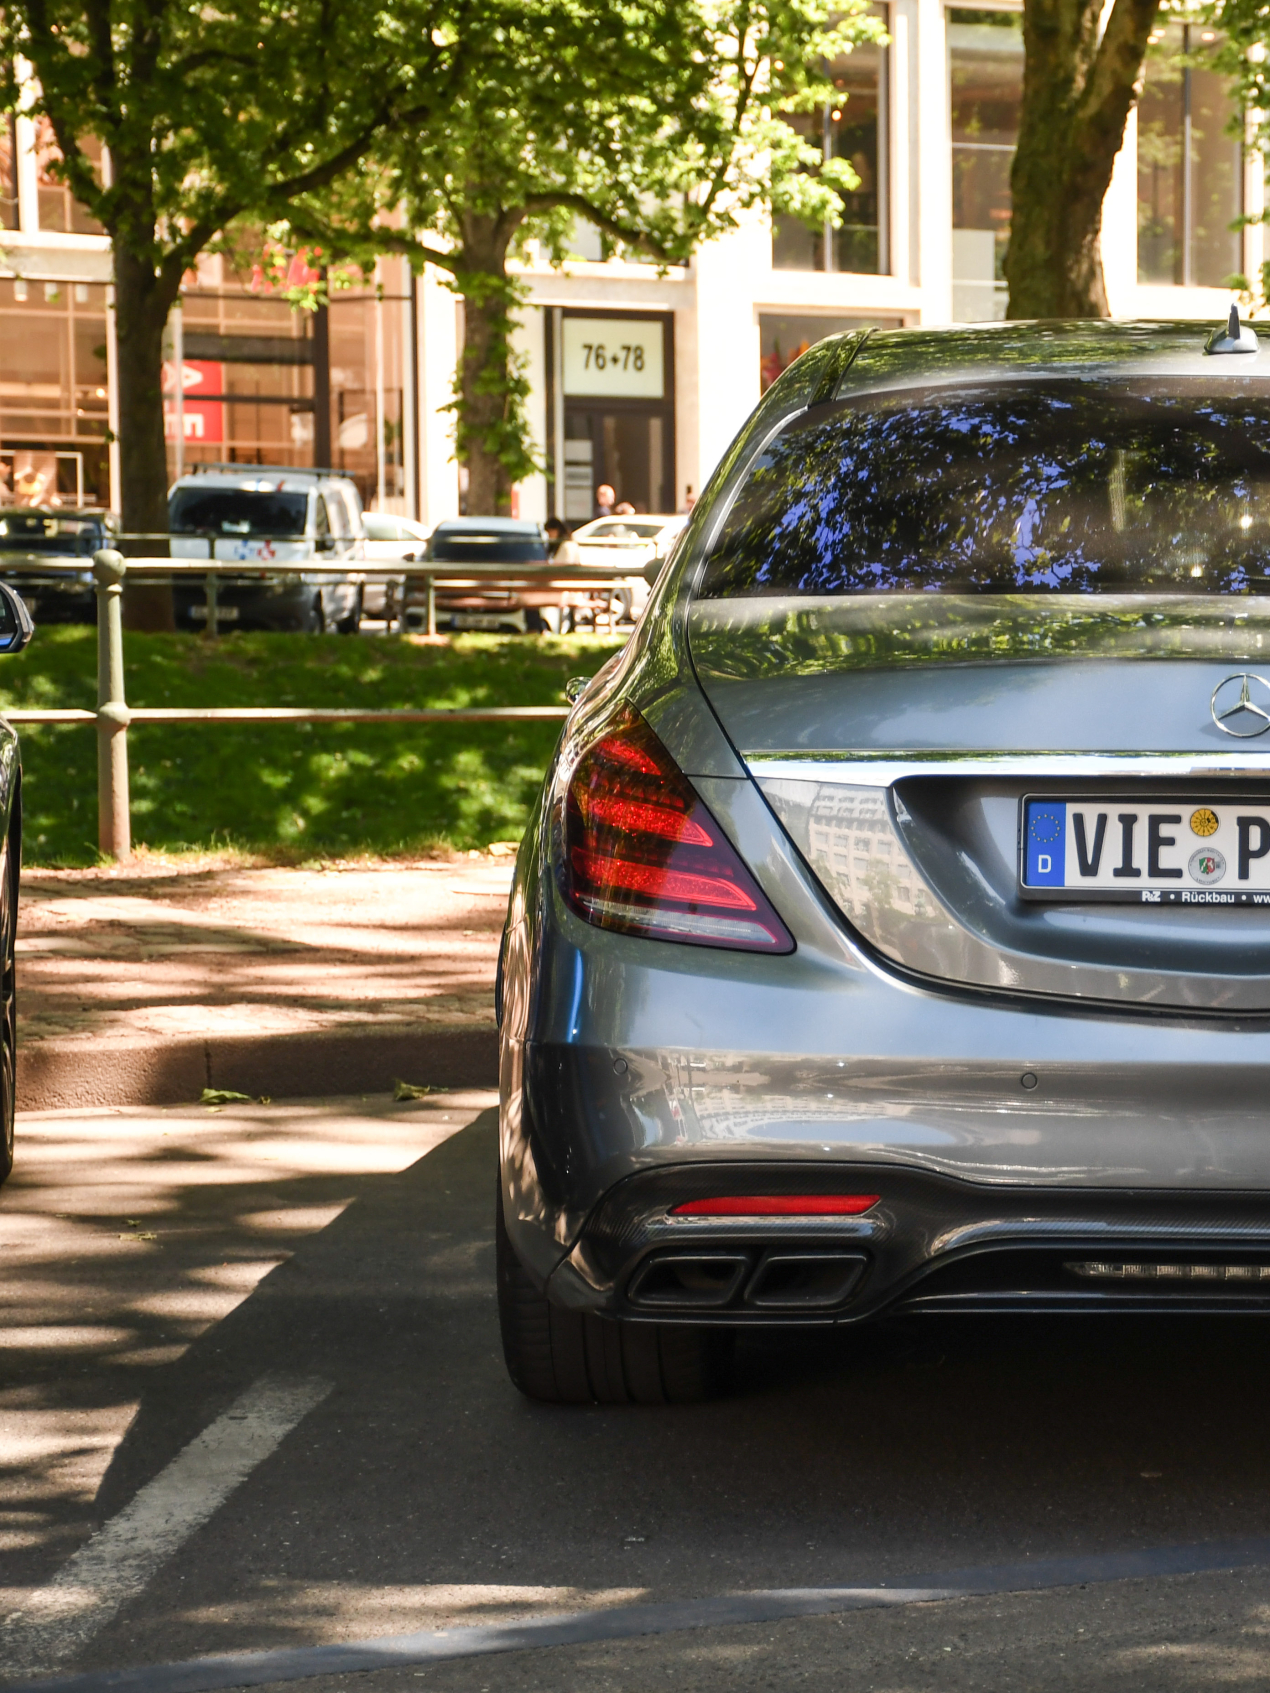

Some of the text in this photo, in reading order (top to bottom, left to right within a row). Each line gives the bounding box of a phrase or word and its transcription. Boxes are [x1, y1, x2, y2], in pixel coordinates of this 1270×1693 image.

[1073, 813, 1183, 878] VIE
[1037, 854, 1052, 874] D
[1182, 891, 1235, 903] Rückbau
